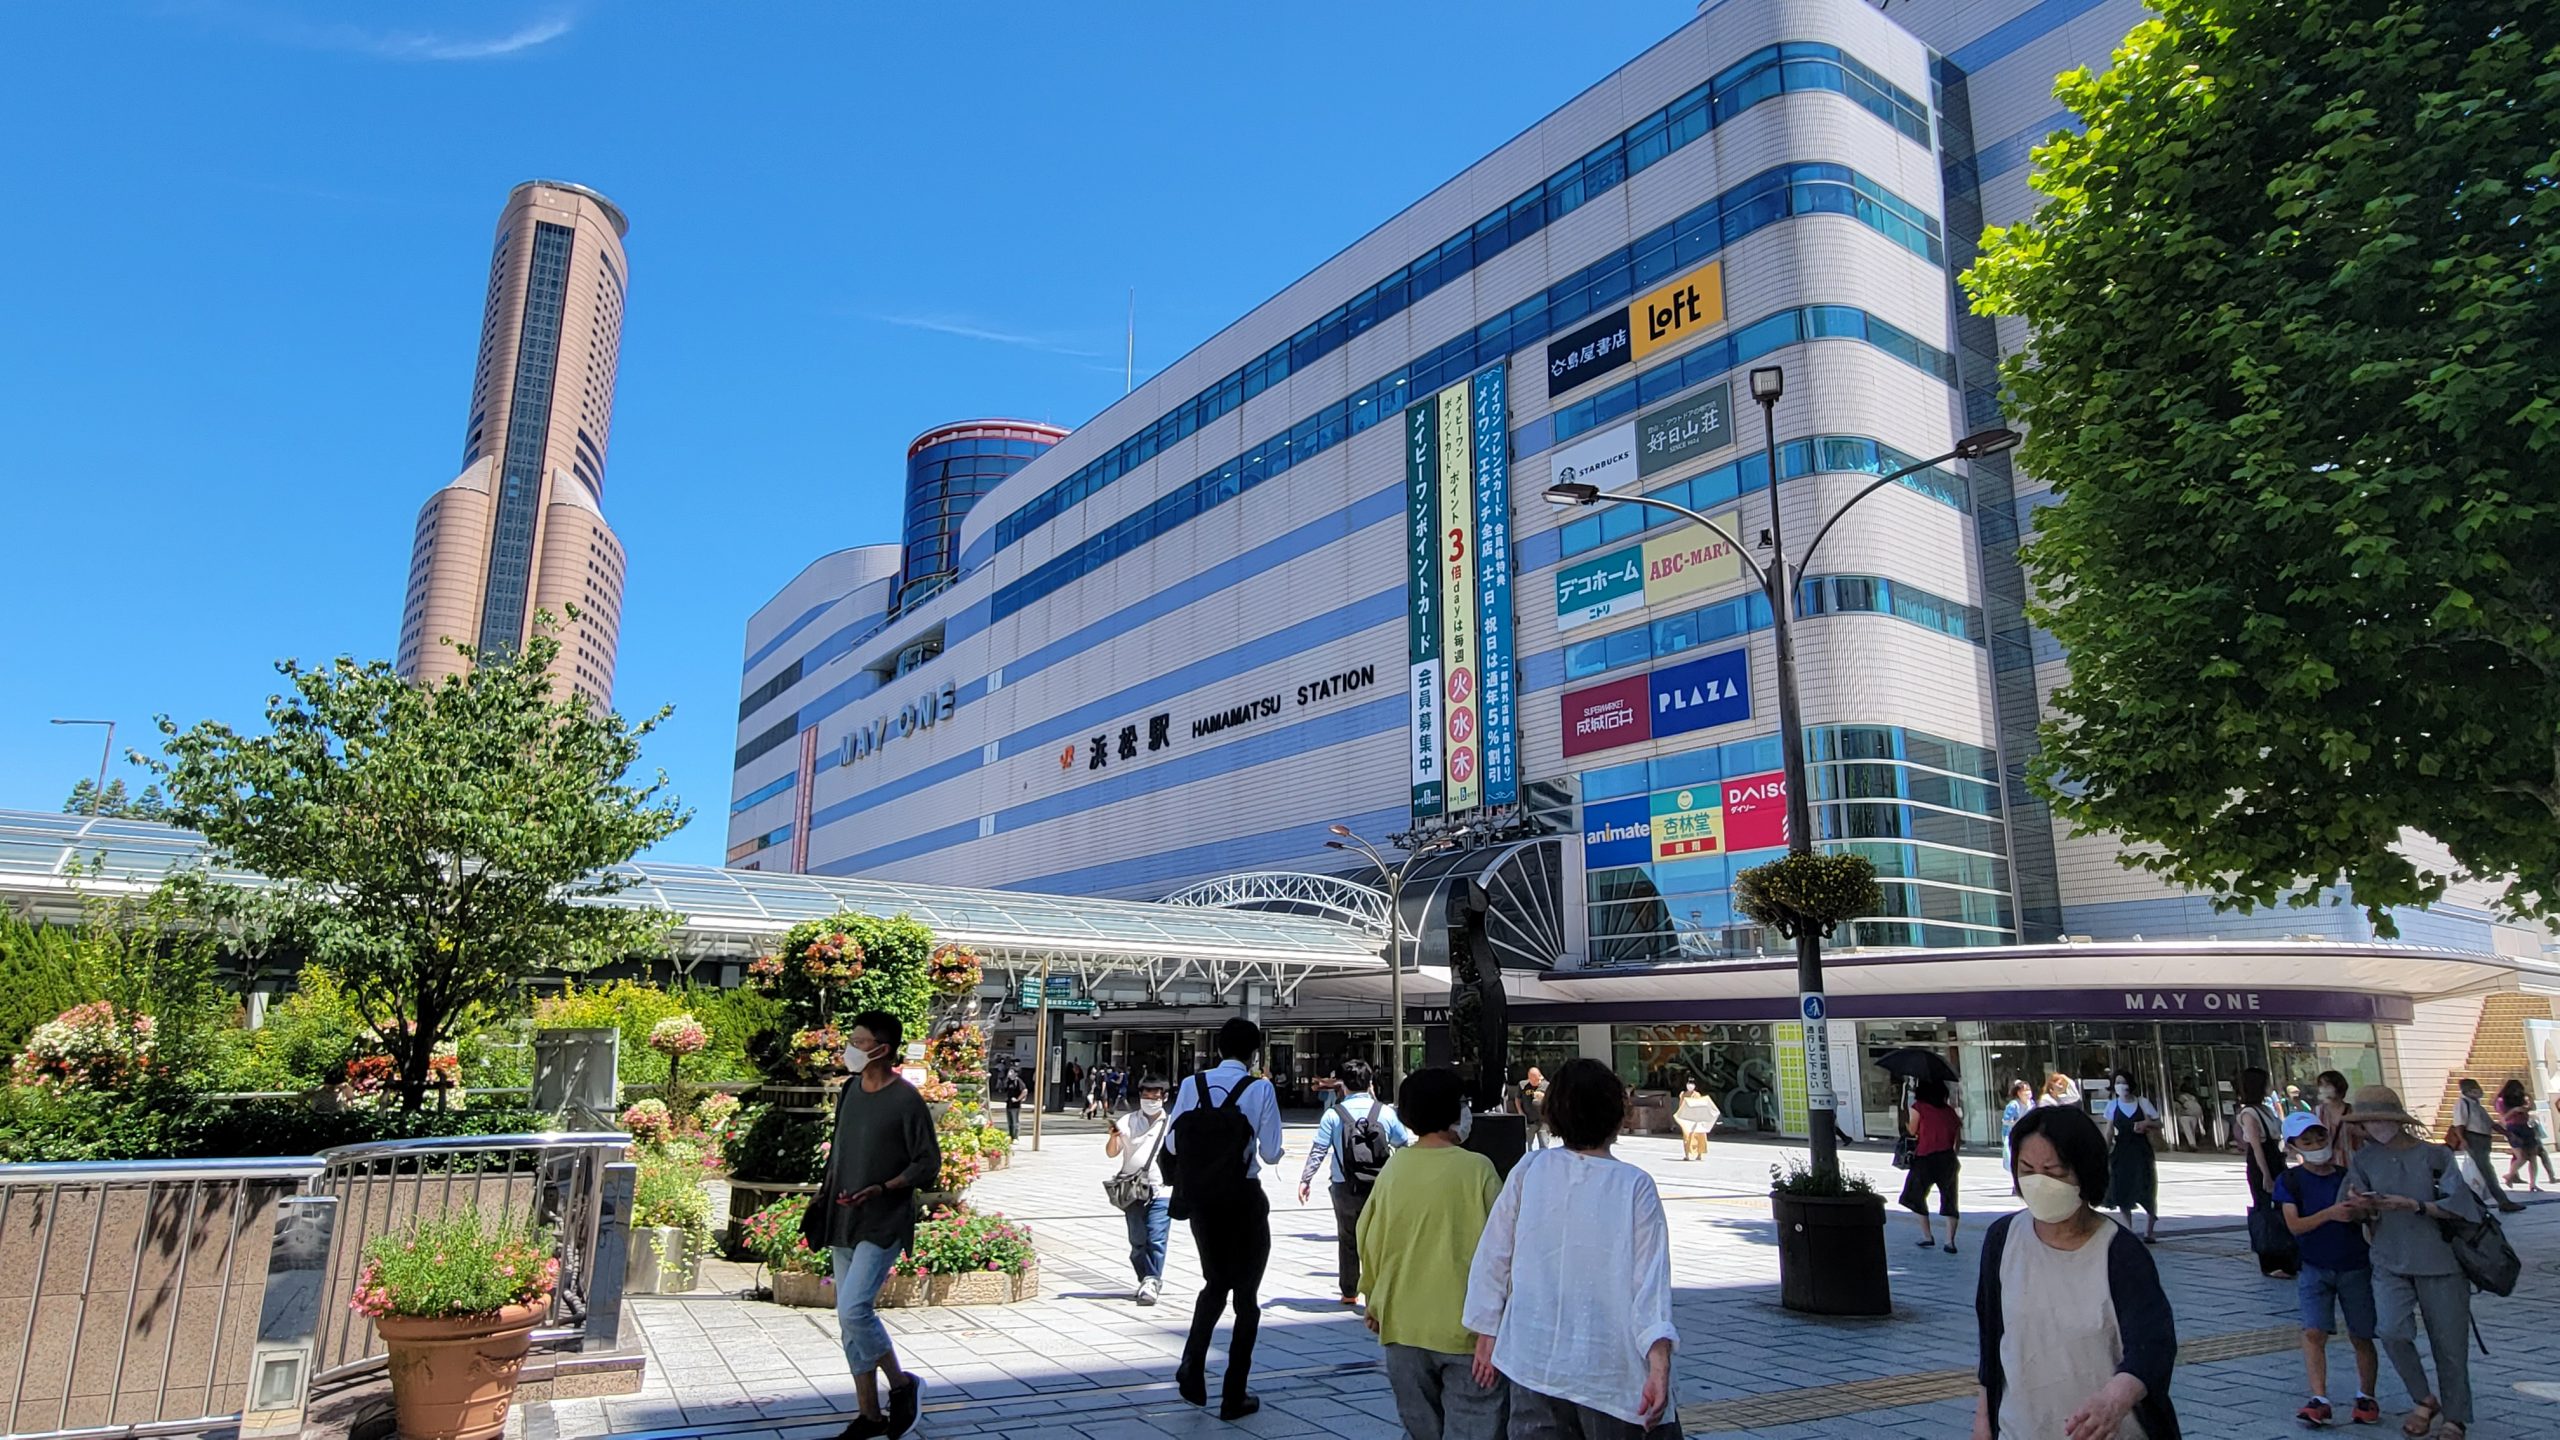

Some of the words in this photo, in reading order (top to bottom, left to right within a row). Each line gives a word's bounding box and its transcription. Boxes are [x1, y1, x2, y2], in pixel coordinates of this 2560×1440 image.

[1551, 328, 1627, 377] 谷島屋書店
[1647, 408, 1720, 454] 好日山荘
[1579, 451, 1630, 477] STARBUCKS
[1650, 541, 1731, 581] ABC-MART
[1559, 559, 1640, 604] デコホーム
[1589, 604, 1610, 620] ニトリ
[1583, 698, 1625, 717] SUPERMARKET
[1658, 677, 1739, 713] PLAZA
[839, 715, 888, 767] MAY
[897, 681, 957, 739] ONE
[1088, 713, 1171, 771] 浜松駅
[1192, 694, 1282, 739] HAMAMATSU
[1297, 664, 1375, 706] STATION
[1418, 668, 1433, 776] 会員募集中
[1576, 707, 1634, 737] 成城石井
[1663, 811, 1711, 836] 杏林堂
[1730, 804, 1756, 815] ダイソー
[1586, 822, 1650, 845] animate
[1423, 1009, 1453, 1021] MAY
[2126, 993, 2188, 1011] MAY
[2204, 993, 2262, 1011] ONE
